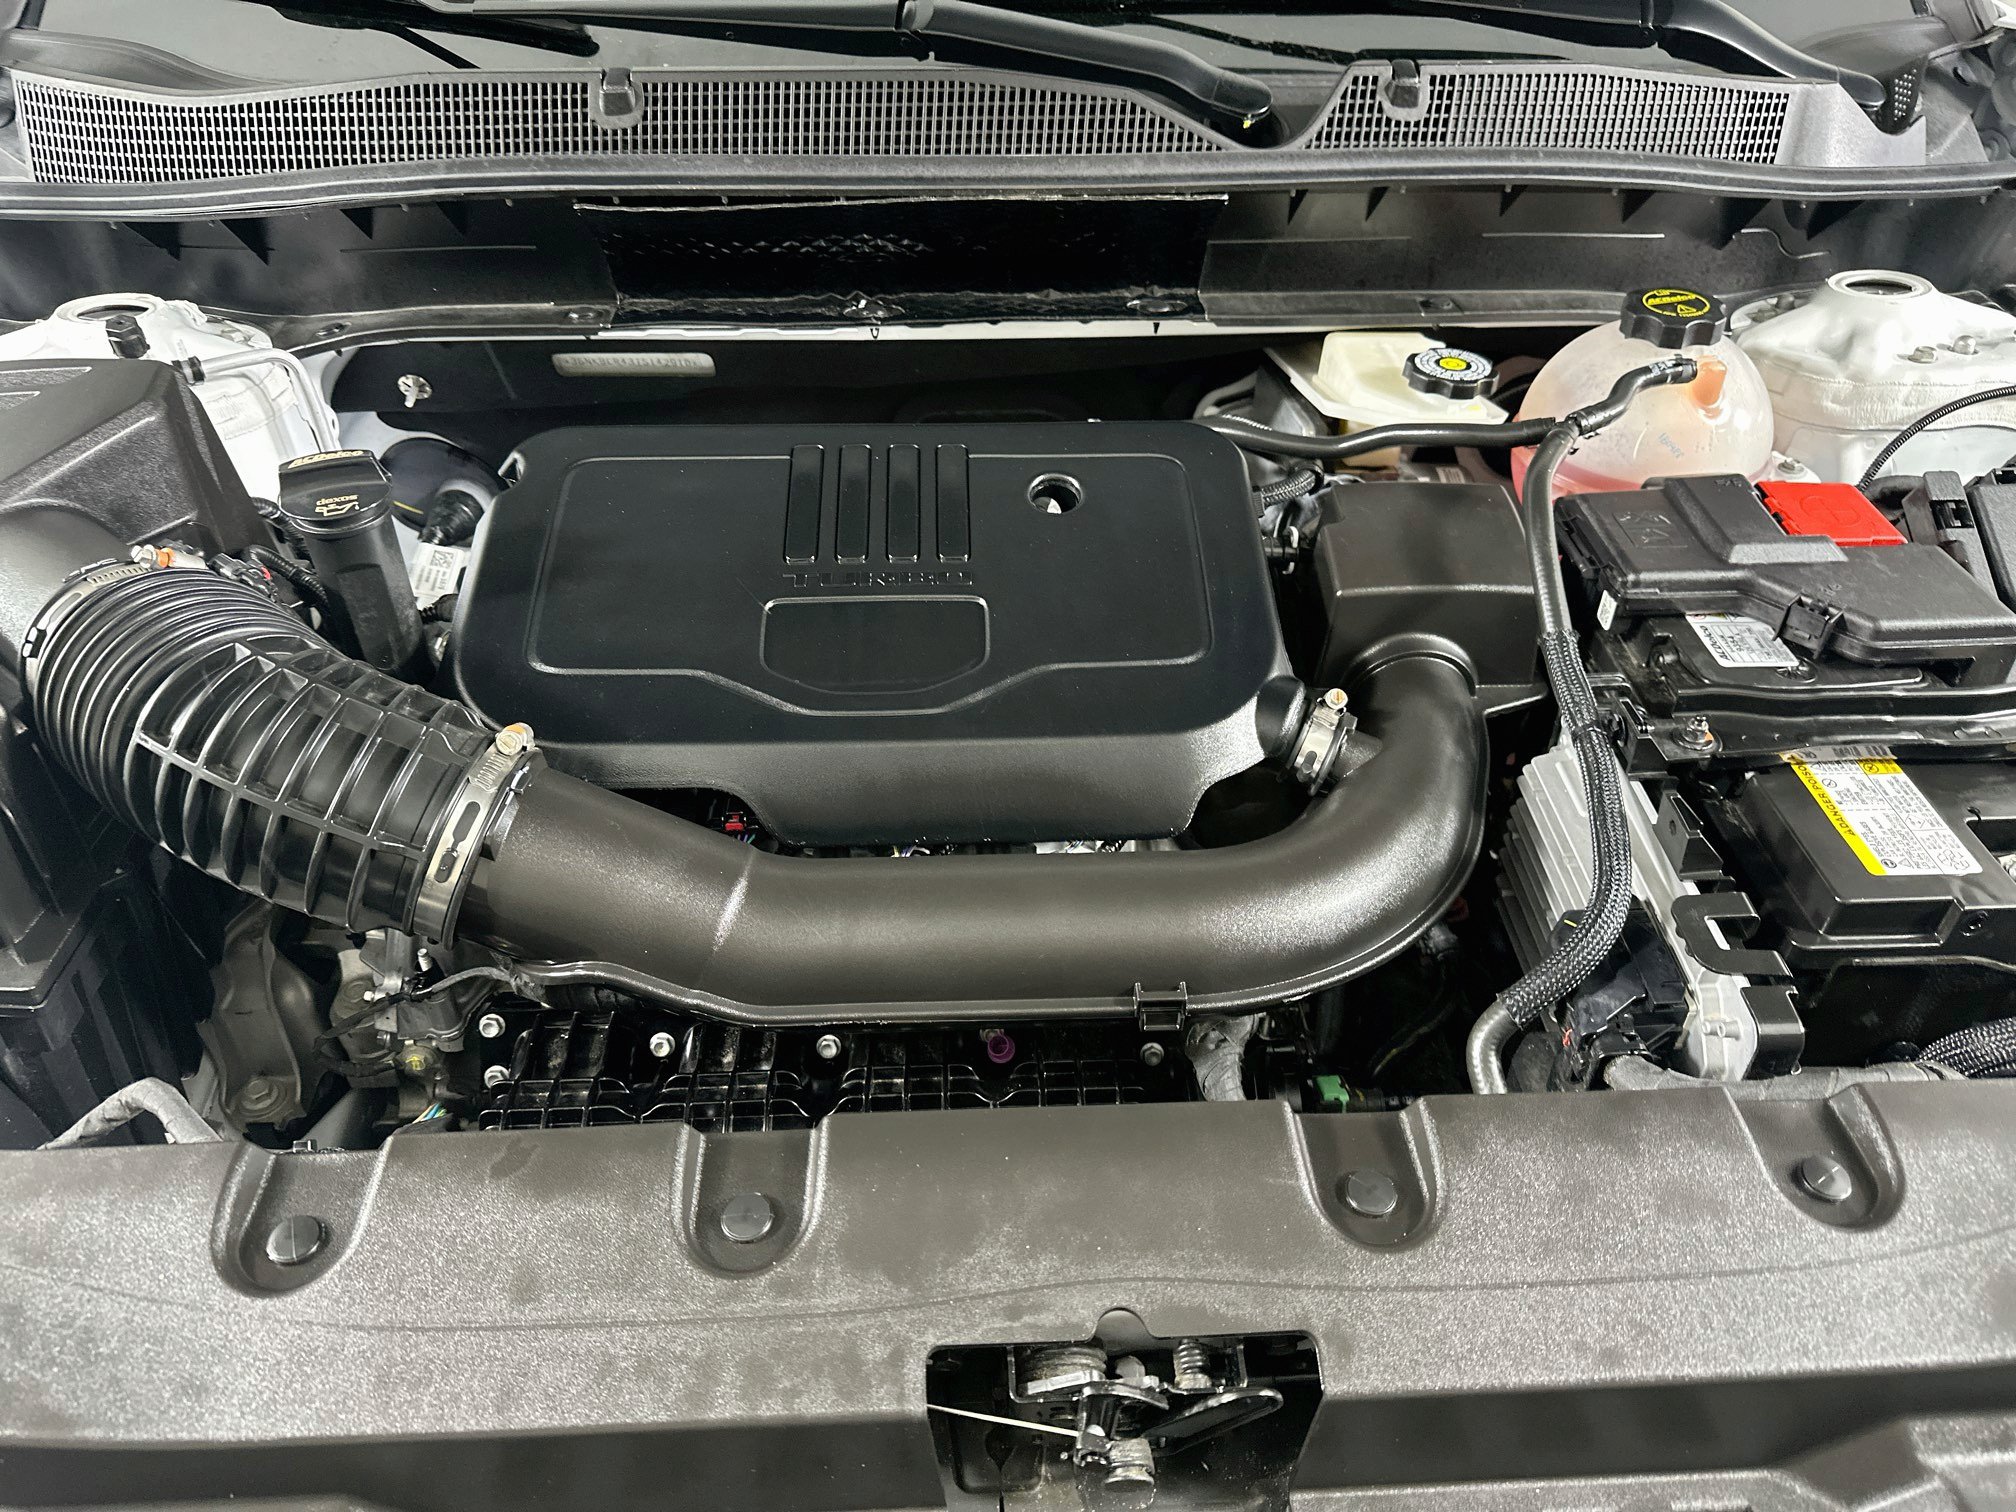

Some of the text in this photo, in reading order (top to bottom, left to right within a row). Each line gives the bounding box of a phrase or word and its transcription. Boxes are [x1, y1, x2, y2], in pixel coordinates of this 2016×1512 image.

[287, 450, 364, 469] ACDelco
[316, 494, 359, 506] dexos
[782, 571, 974, 588] TURBO
